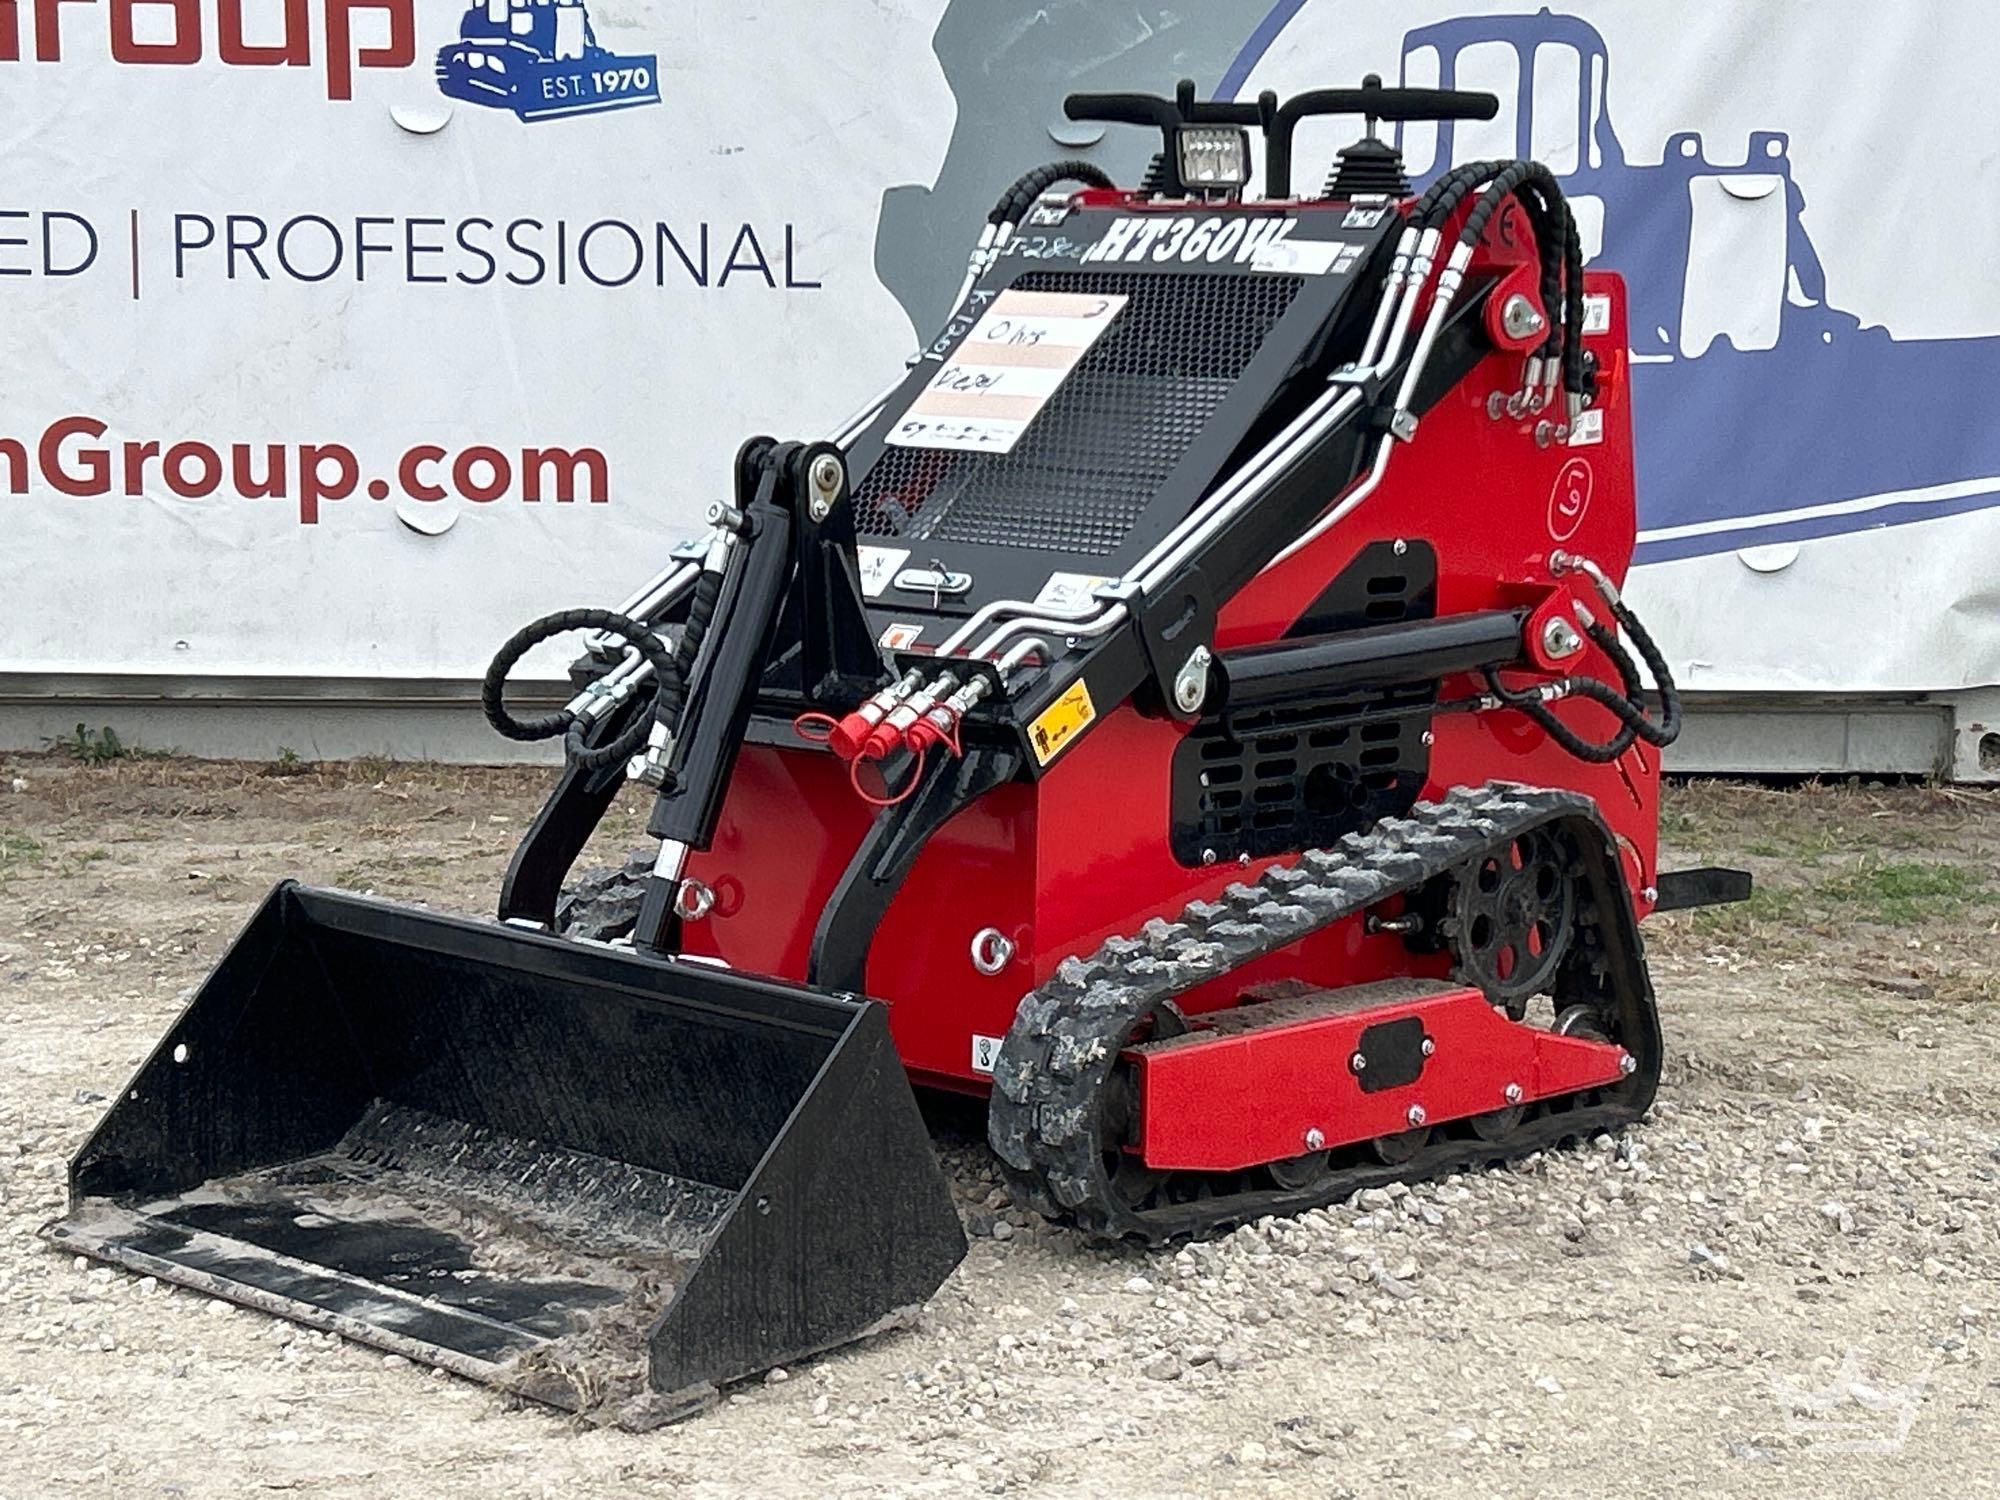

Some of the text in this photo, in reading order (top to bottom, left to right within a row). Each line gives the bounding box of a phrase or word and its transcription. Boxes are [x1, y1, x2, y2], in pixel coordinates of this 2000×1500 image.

[0, 0, 415, 100] roup
[543, 67, 650, 99] EST. 1970
[174, 213, 823, 289] PROFESSIONAL
[1087, 217, 1298, 264] HT360W
